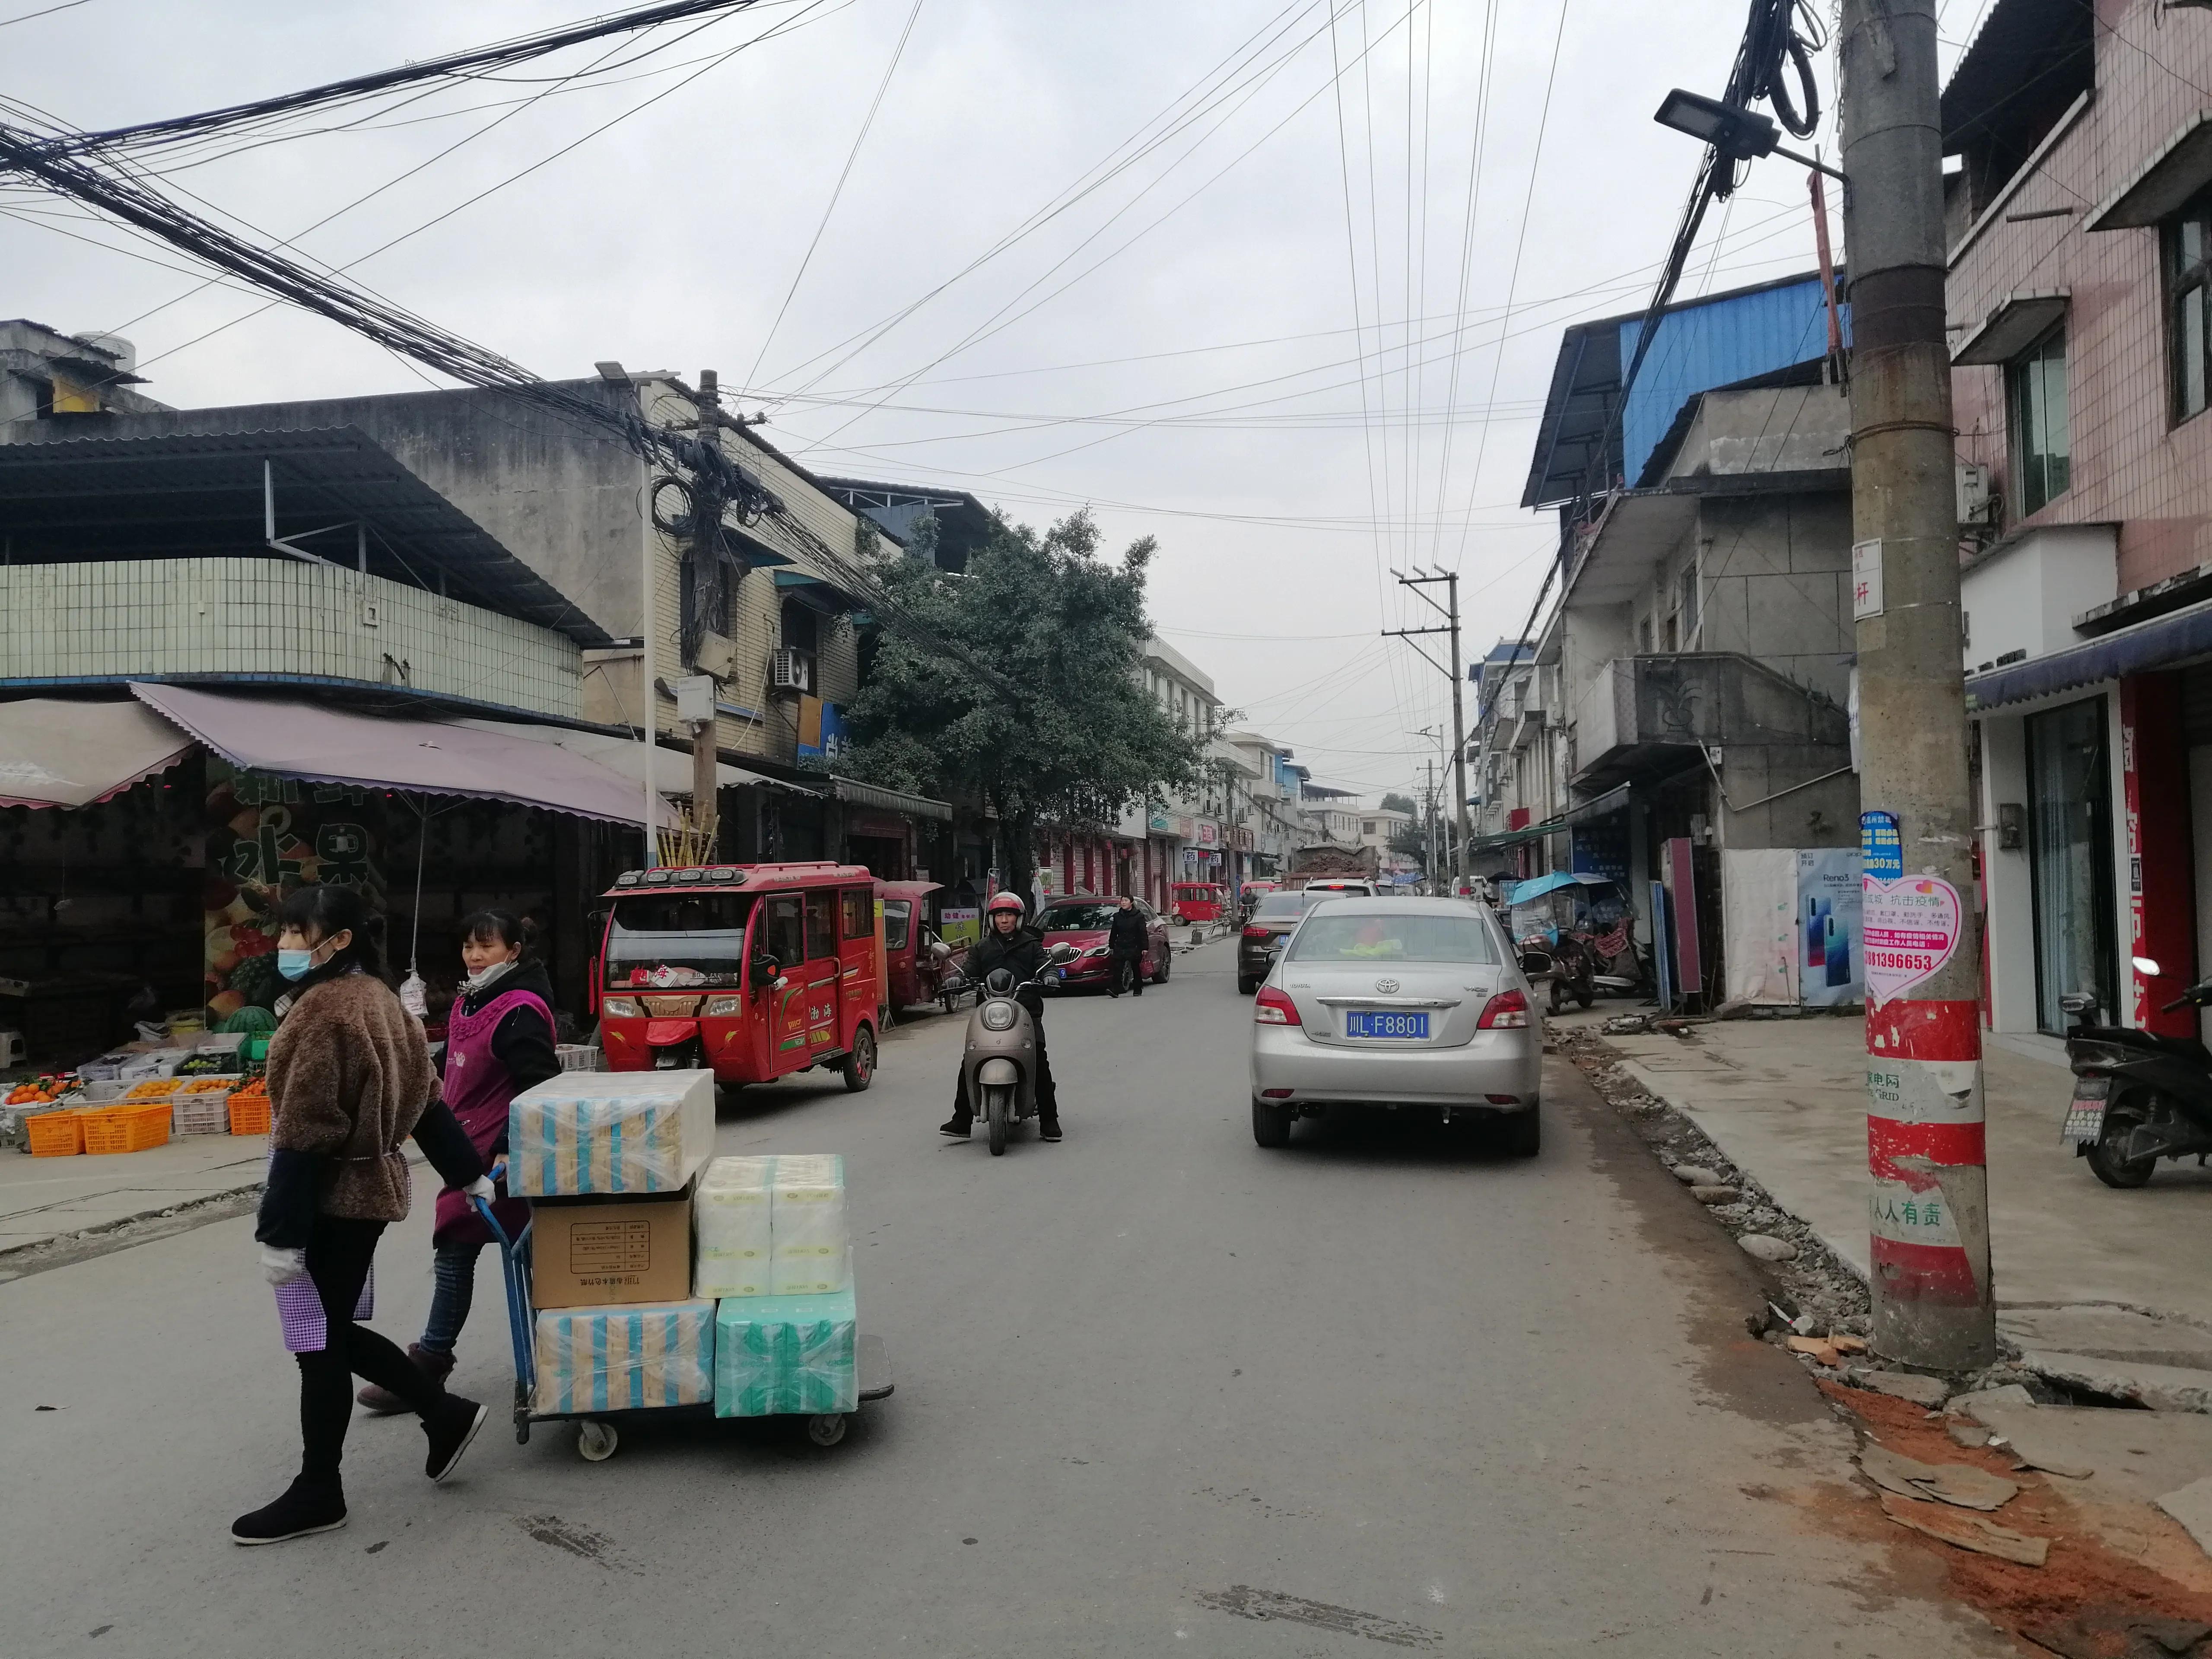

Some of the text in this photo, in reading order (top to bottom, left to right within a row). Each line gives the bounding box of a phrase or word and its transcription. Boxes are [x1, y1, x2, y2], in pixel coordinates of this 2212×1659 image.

[1186, 852, 1195, 860] 药
[1211, 855, 1219, 863] 药
[1891, 895, 1940, 907] 抗击疫情
[788, 1019, 802, 1031] VIP
[1874, 1196, 1941, 1227] 人人有责
